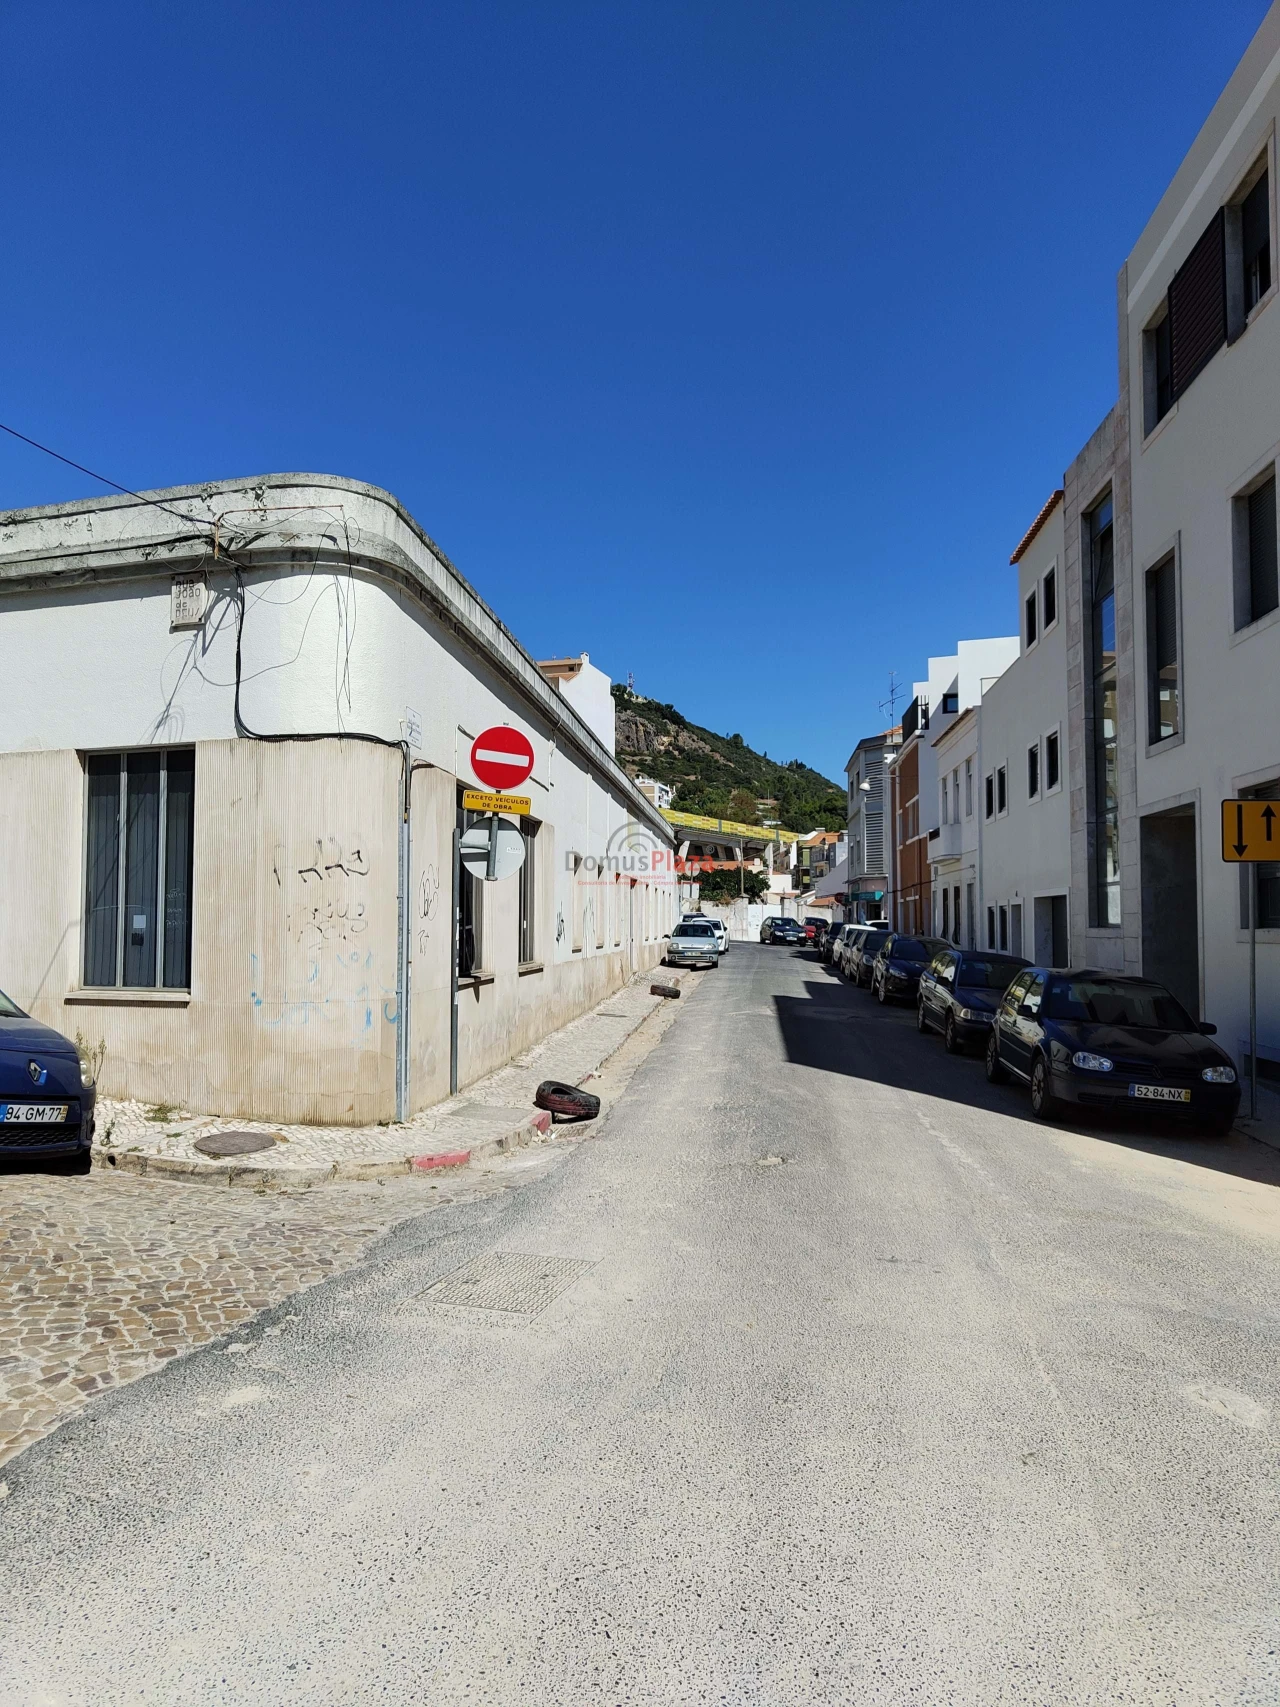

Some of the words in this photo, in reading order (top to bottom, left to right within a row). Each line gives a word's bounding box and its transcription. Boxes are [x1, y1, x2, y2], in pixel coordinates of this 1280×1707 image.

[176, 599, 187, 608] de
[466, 794, 493, 802] EXCETO
[495, 796, 529, 805] VEÍCULOS
